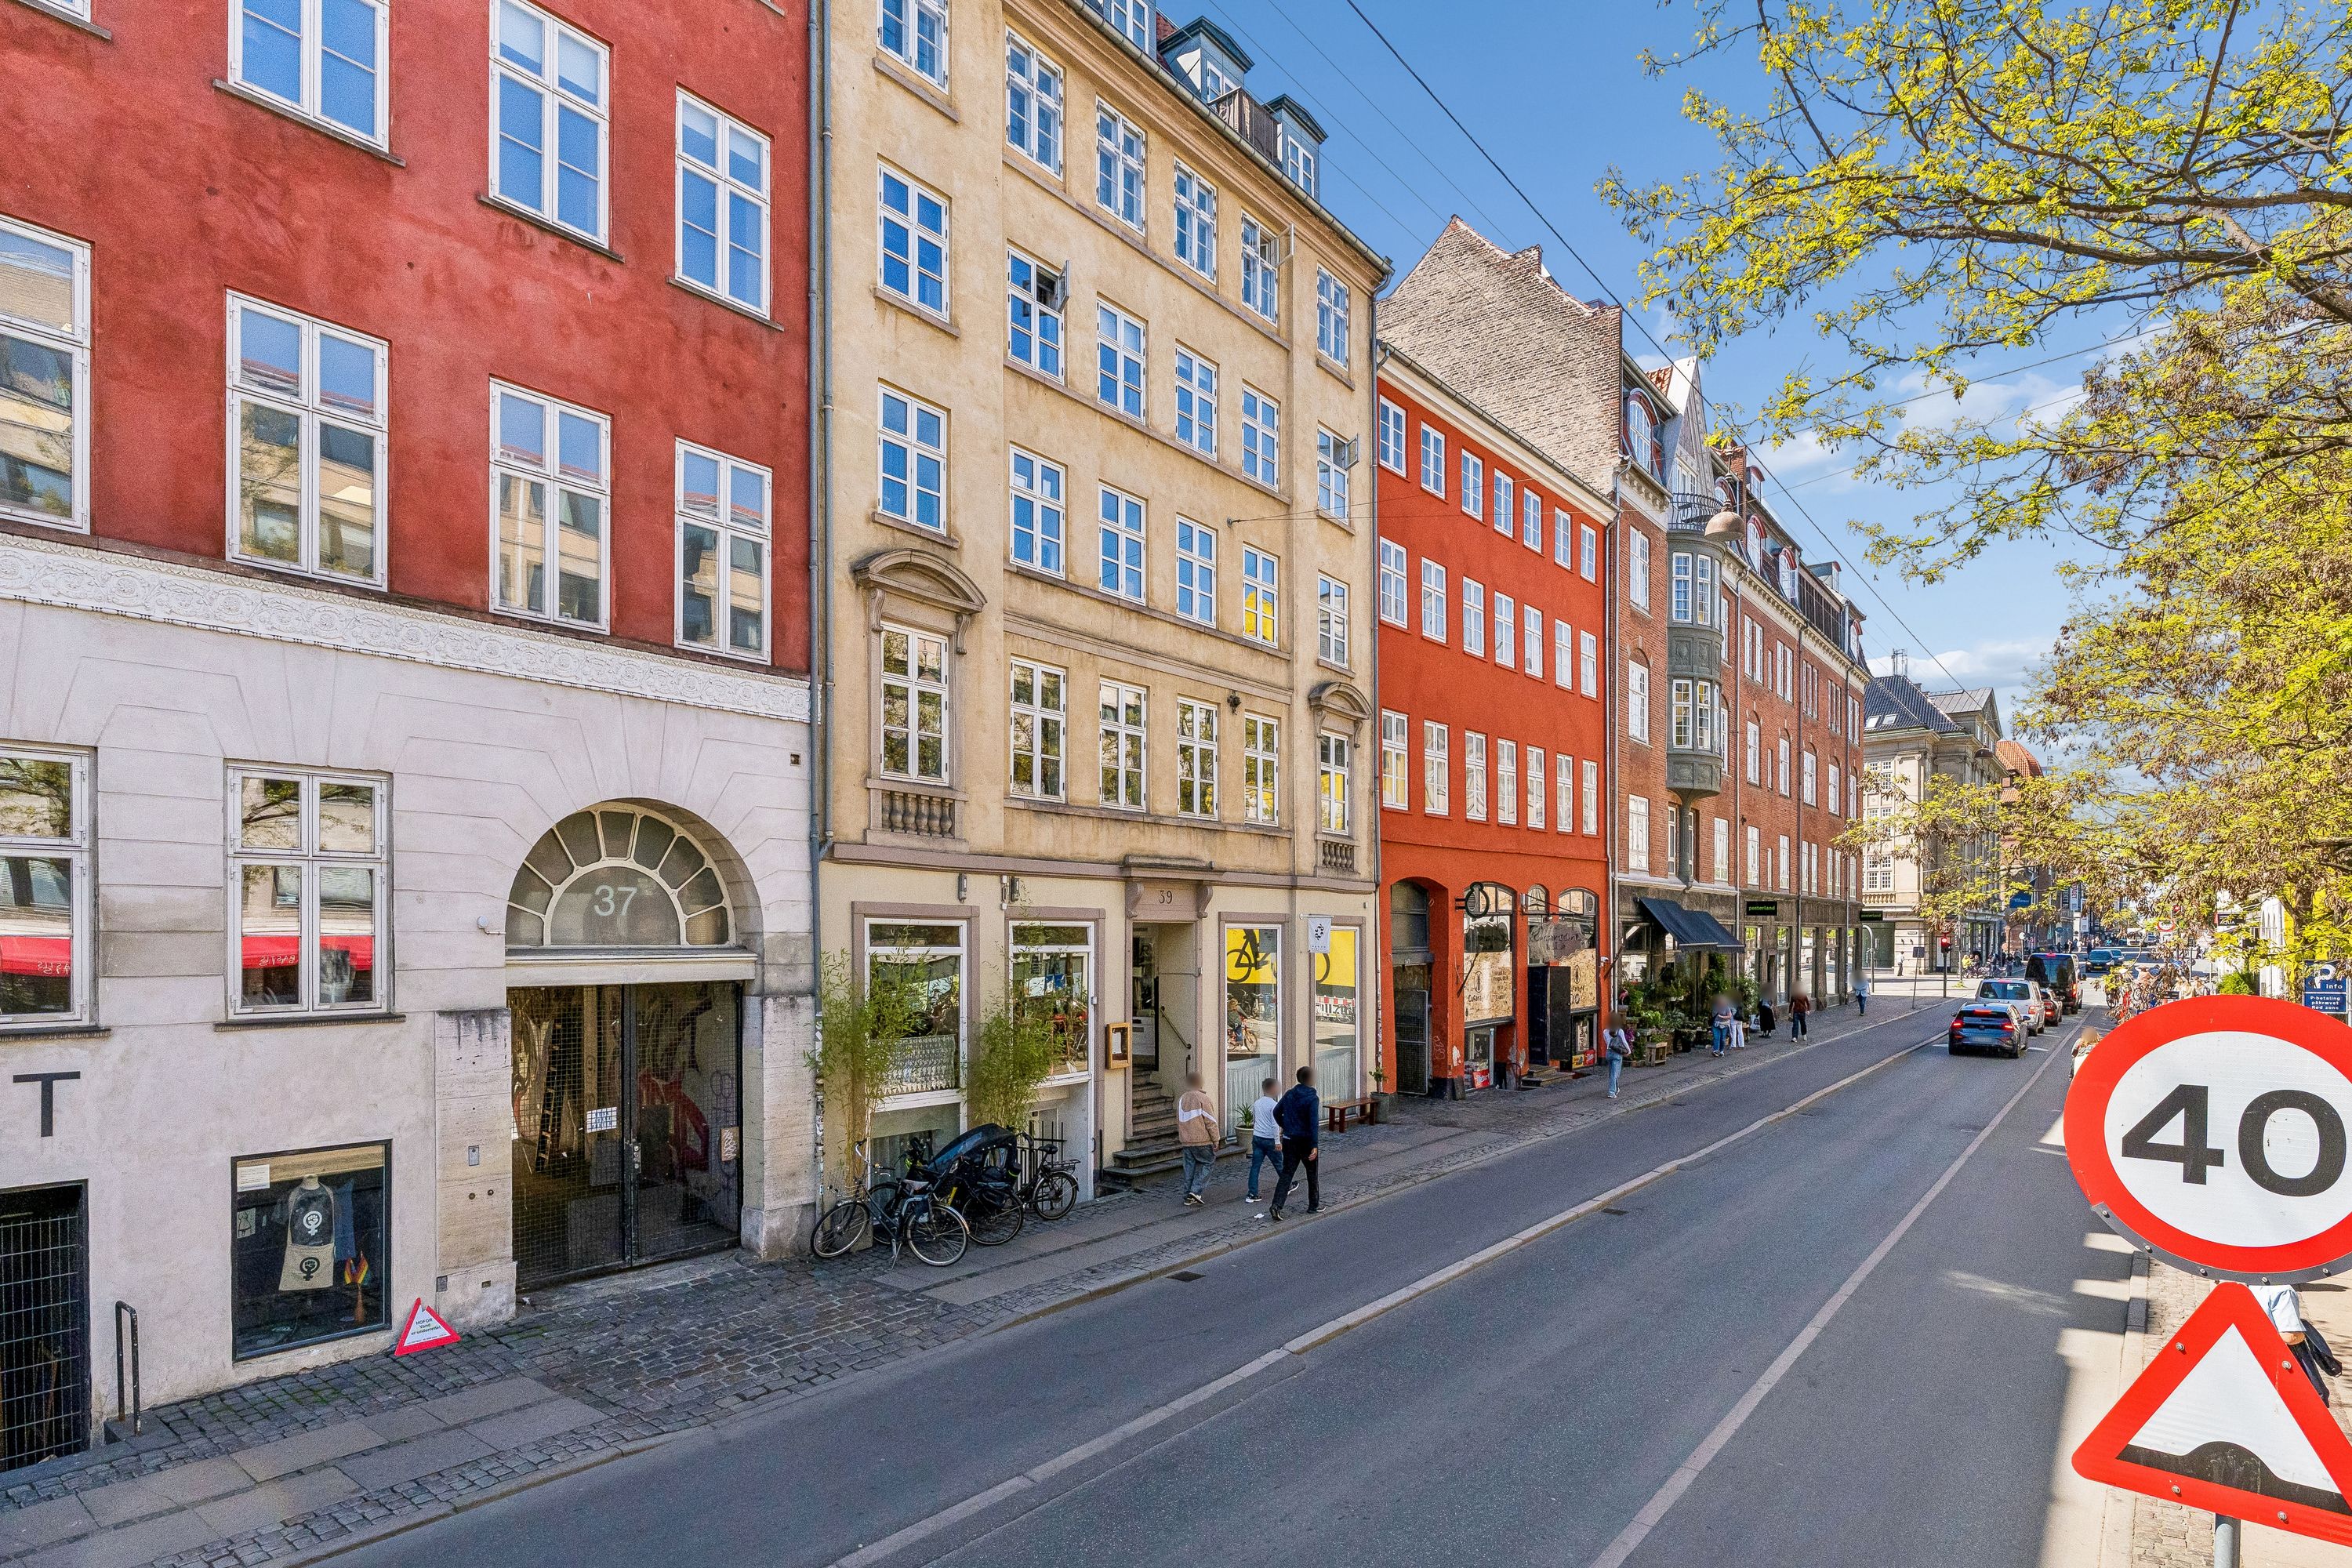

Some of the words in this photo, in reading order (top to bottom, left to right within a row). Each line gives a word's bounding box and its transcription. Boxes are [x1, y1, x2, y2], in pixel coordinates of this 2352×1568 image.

[594, 884, 637, 916] 37
[1158, 890, 1173, 904] 39
[2314, 964, 2336, 989] P
[13, 1071, 81, 1138] T
[2122, 1083, 2347, 1197] 40
